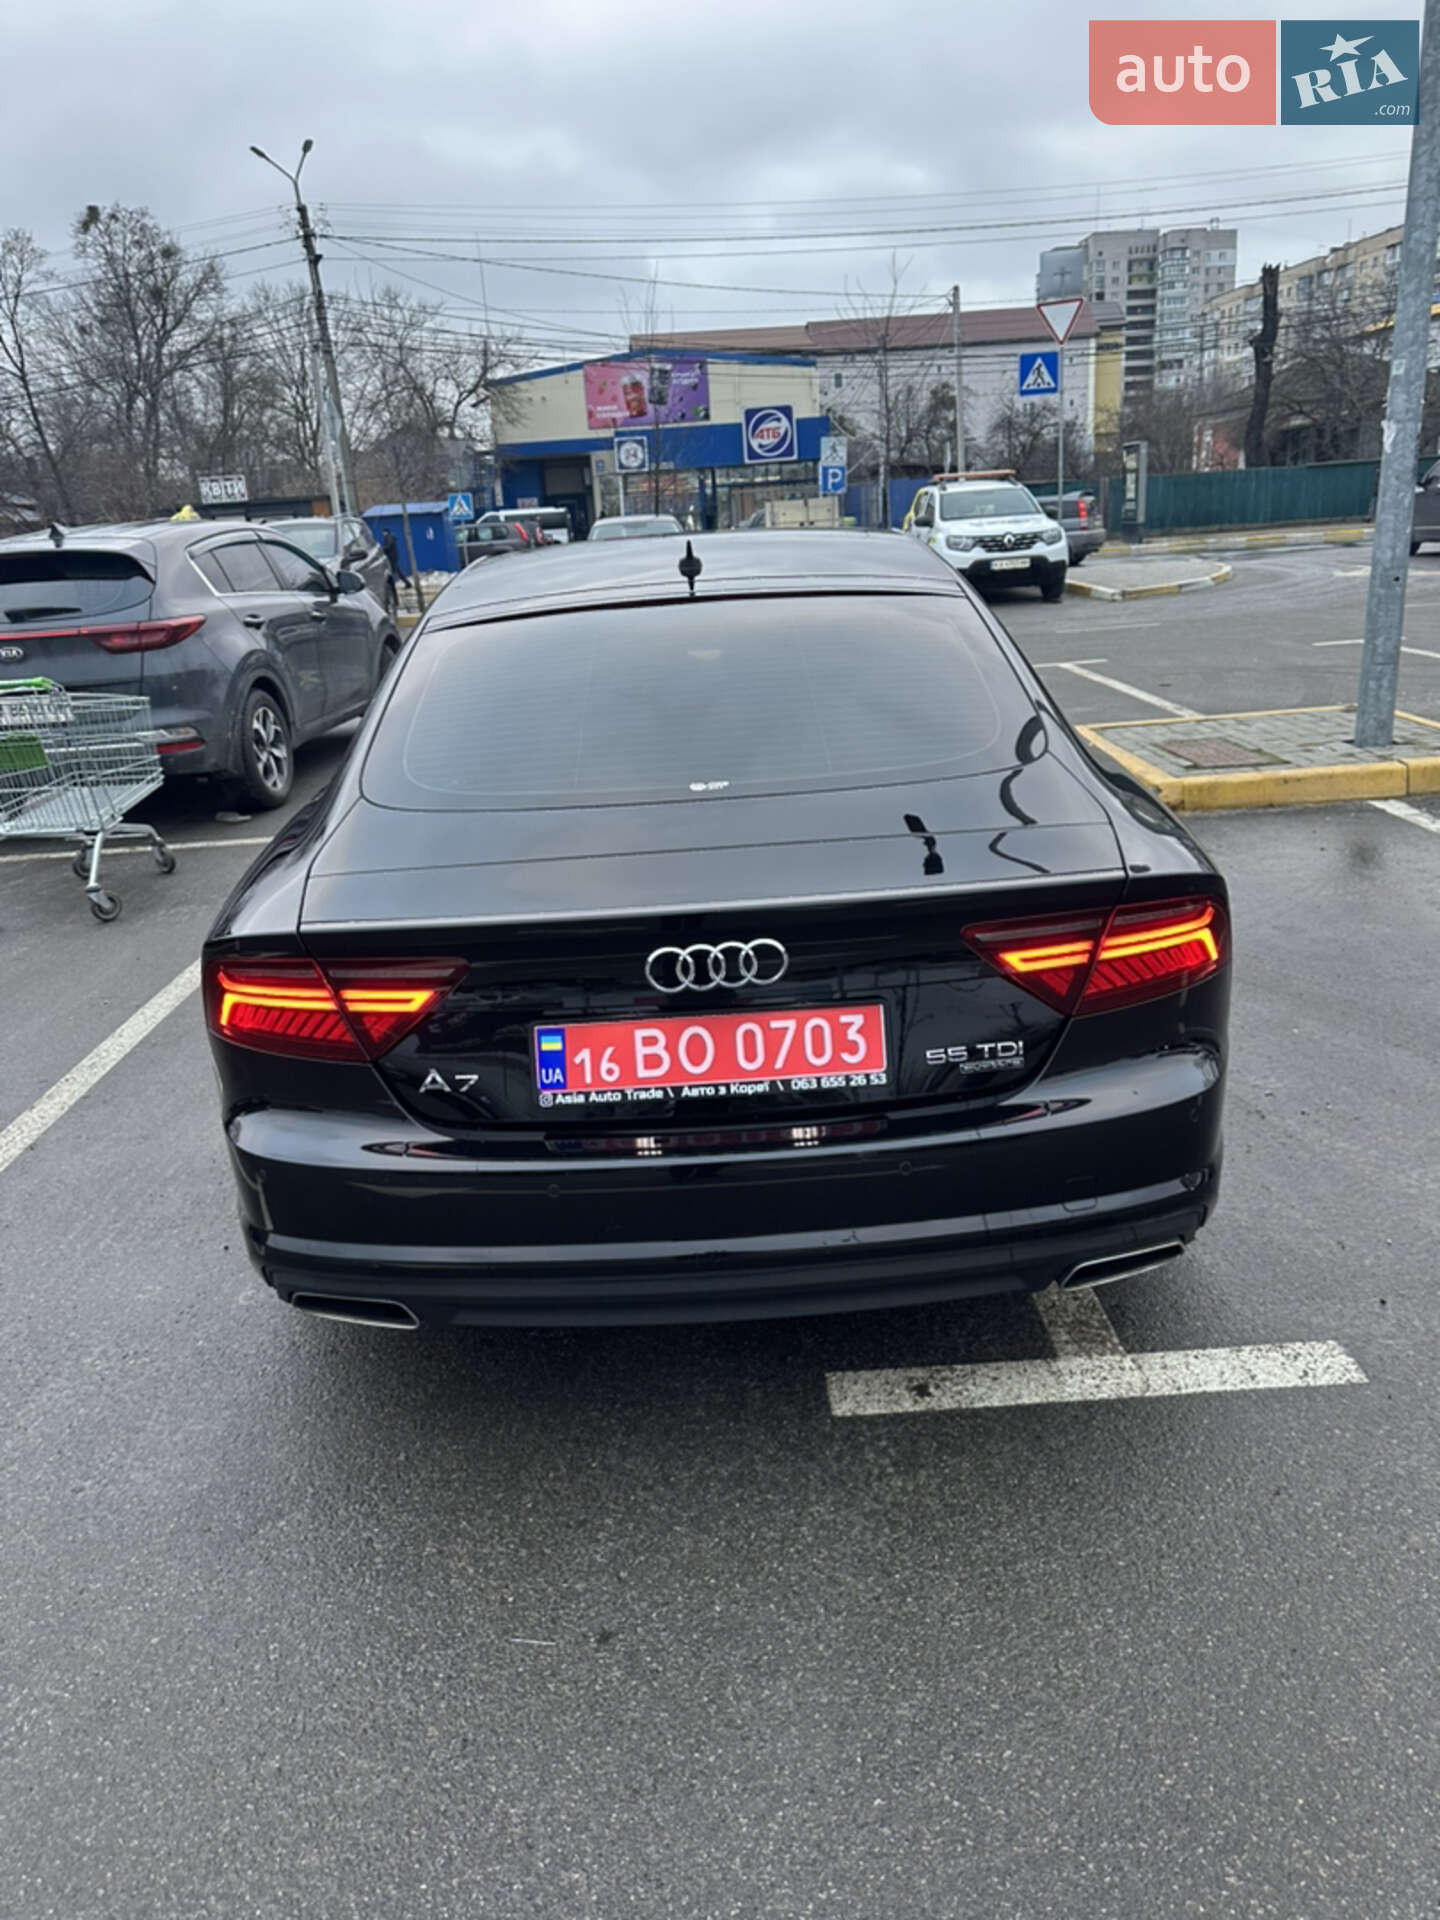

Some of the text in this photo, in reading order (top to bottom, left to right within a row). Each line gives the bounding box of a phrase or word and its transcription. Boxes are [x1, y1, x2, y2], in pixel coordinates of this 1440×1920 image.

[827, 468, 842, 491] P
[573, 1013, 868, 1085] 16 BO 0703
[925, 1040, 1024, 1065] 55 TDI
[419, 1068, 479, 1093] A7
[542, 1067, 565, 1085] UA
[555, 1093, 586, 1105] Asia
[588, 1090, 622, 1103] Auto
[624, 1087, 664, 1101] Trade
[681, 1085, 715, 1098] Авто
[730, 1080, 770, 1096] Кореї
[790, 1078, 818, 1091] 063
[820, 1076, 847, 1089] 655
[849, 1074, 867, 1087] 26
[869, 1072, 888, 1086] 53
